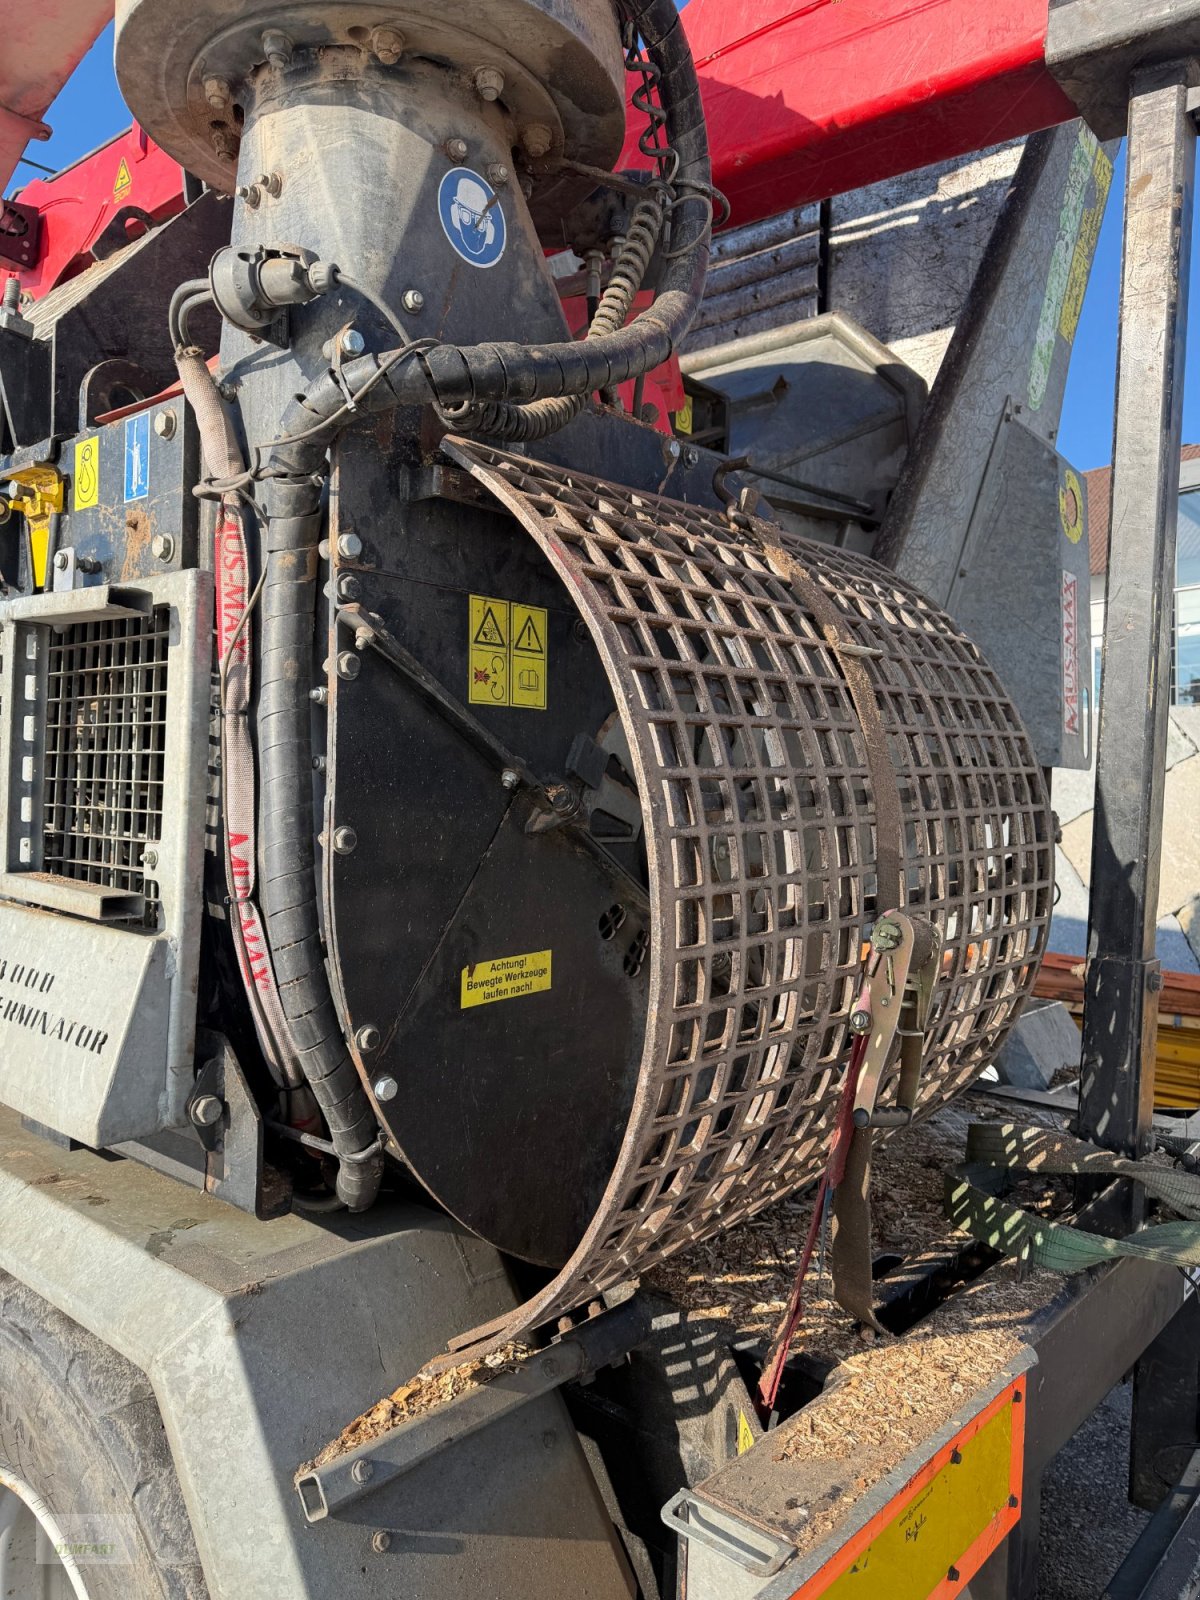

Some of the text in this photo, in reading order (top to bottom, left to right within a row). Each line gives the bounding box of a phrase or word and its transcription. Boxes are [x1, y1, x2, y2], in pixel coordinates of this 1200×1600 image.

[490, 957, 527, 973] Achtung!
[466, 967, 548, 991] Bewegte Werkzeuge
[483, 981, 533, 1001] laufen nach!
